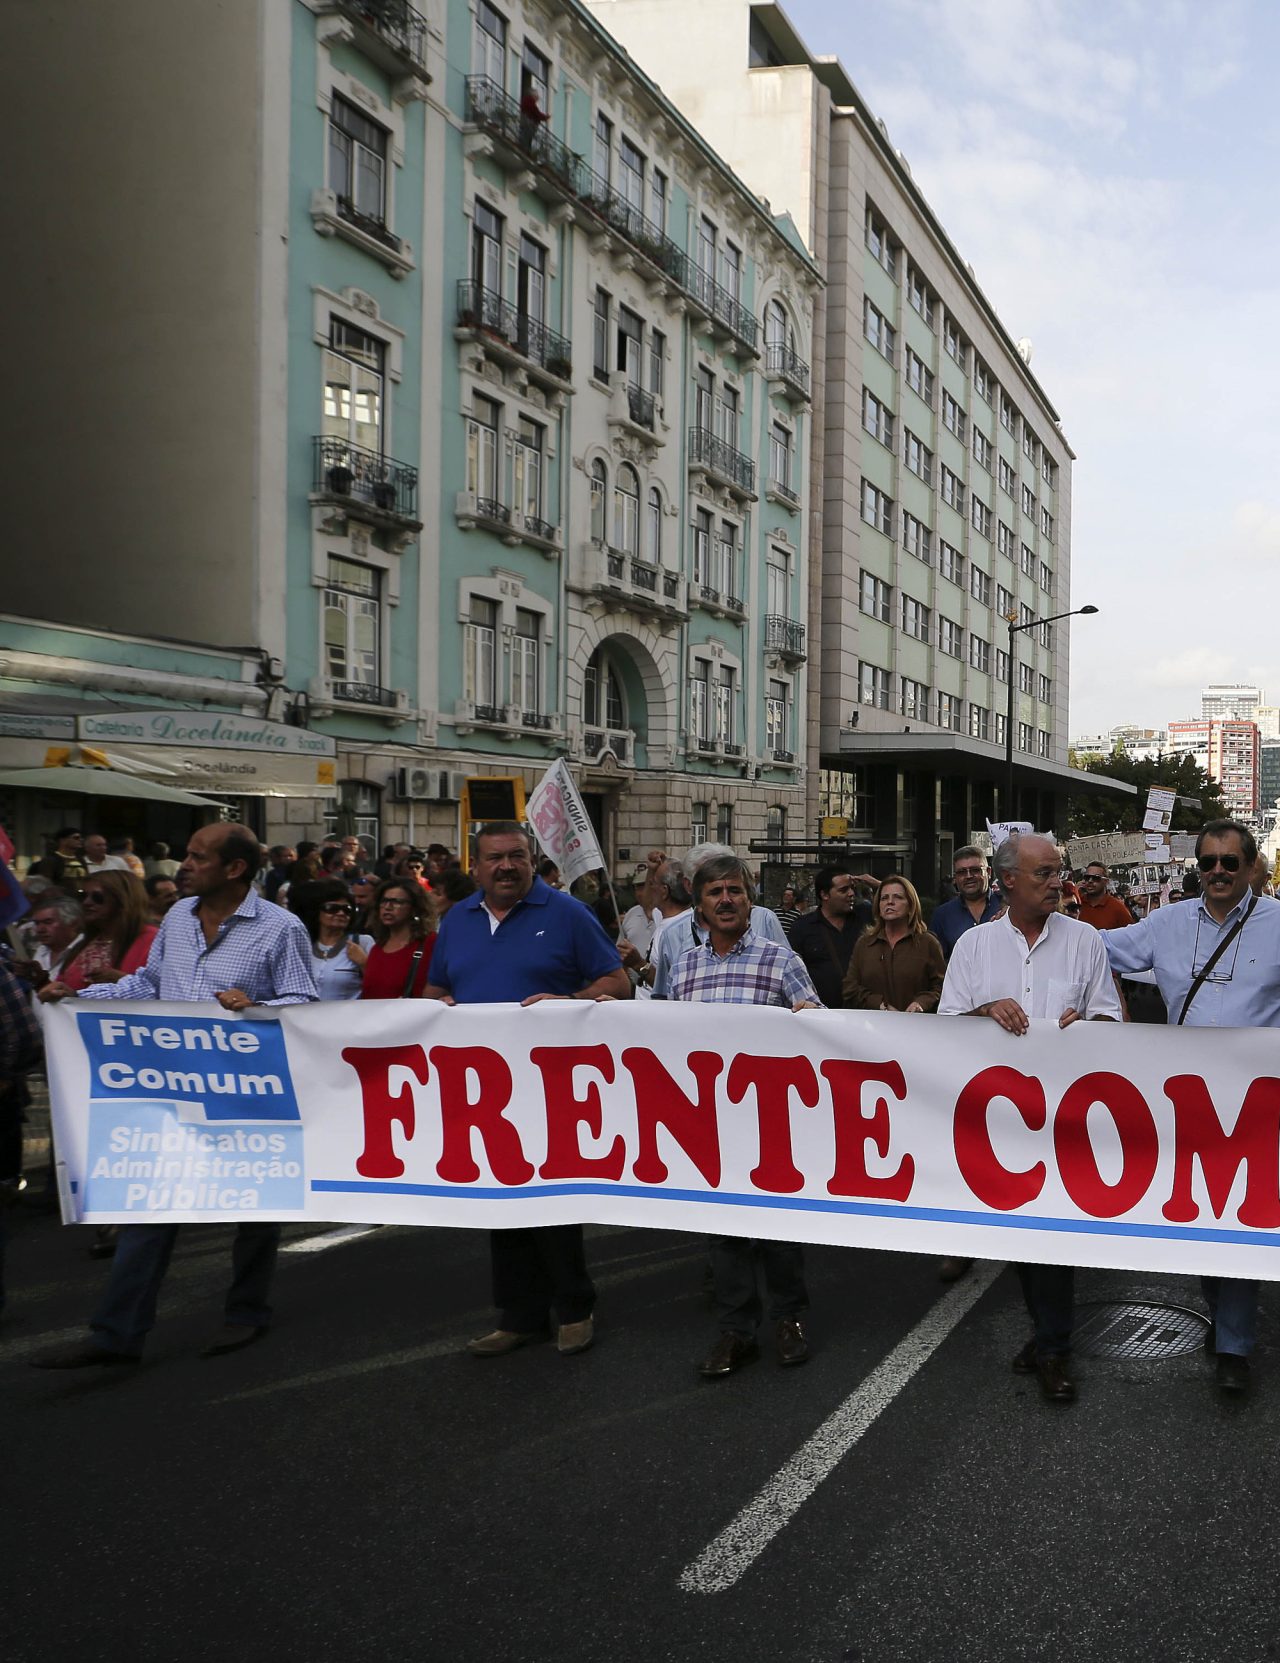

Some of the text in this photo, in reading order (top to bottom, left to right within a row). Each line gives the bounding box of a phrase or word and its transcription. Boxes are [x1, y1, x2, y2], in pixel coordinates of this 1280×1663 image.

[151, 715, 287, 747] Docelândia
[184, 760, 256, 774] Docelândia
[99, 1019, 260, 1053] Frente
[98, 1062, 284, 1095] Comum
[109, 1126, 286, 1152] Sindicatos
[343, 1045, 915, 1208] FRENTE
[91, 1156, 301, 1184] Administração
[125, 1182, 258, 1210] Pública
